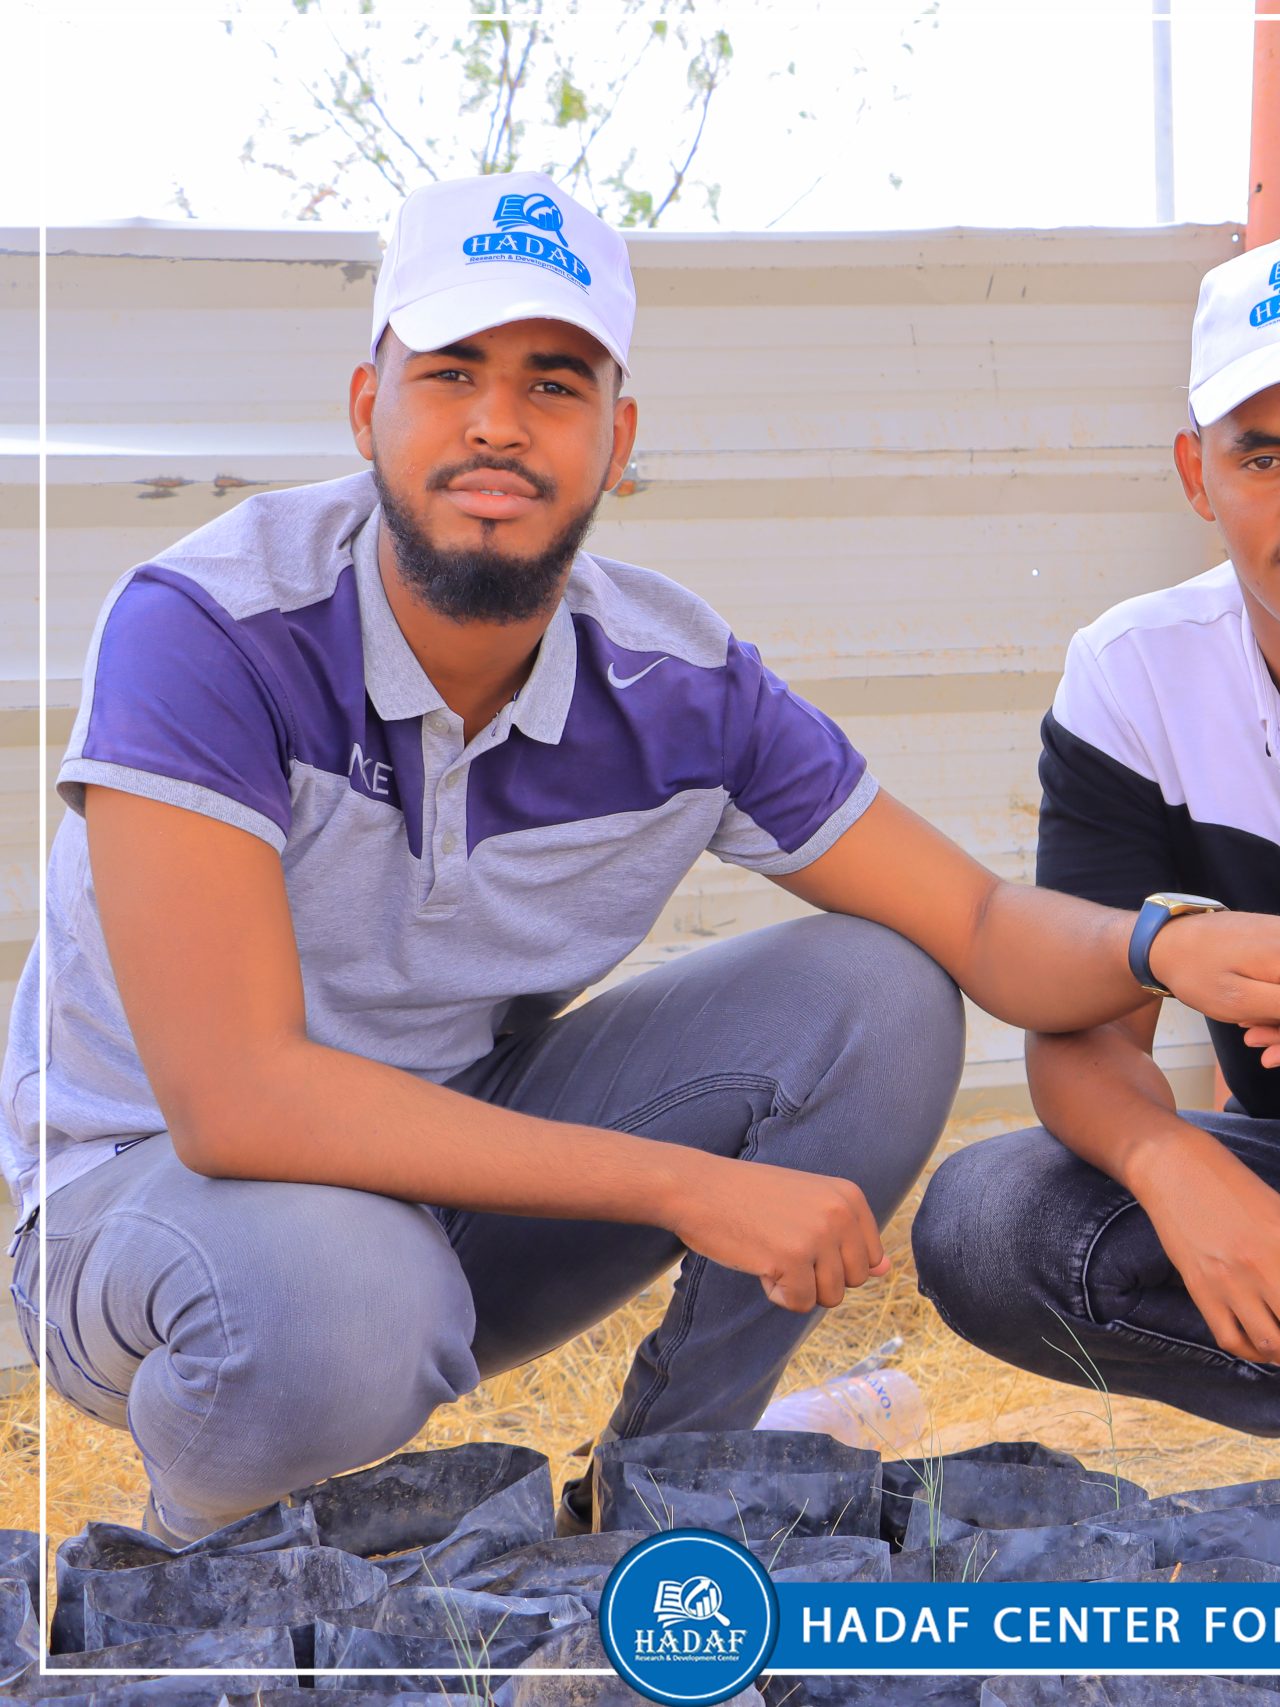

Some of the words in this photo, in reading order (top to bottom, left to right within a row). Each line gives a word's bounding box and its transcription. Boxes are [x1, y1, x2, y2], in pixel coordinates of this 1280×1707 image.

[469, 254, 506, 262] Research
[516, 255, 566, 276] Development
[471, 234, 586, 275] HADAF
